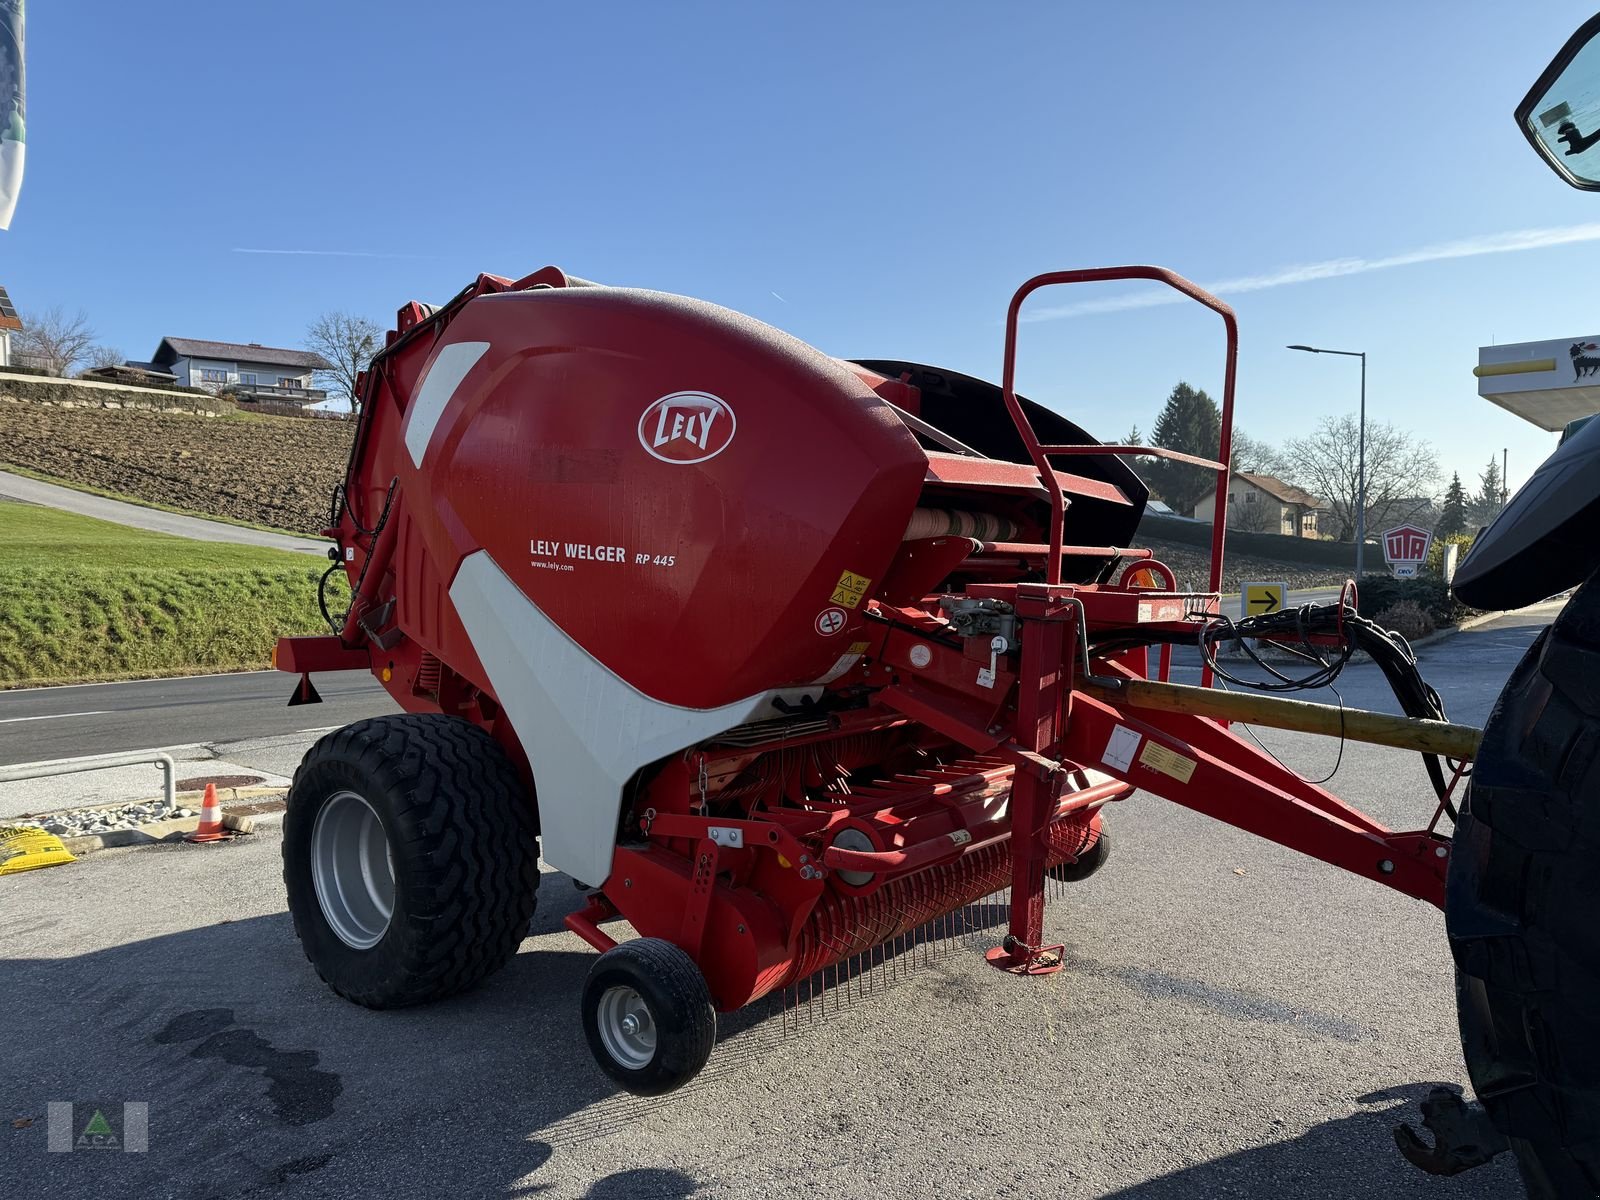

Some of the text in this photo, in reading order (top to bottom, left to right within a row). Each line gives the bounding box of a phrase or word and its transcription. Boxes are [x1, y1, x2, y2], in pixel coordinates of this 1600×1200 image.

[653, 404, 719, 450] LELY
[530, 539, 675, 567] LELY WELGER RP 445
[1387, 528, 1427, 559] UTA
[531, 560, 574, 572] www.lely.com
